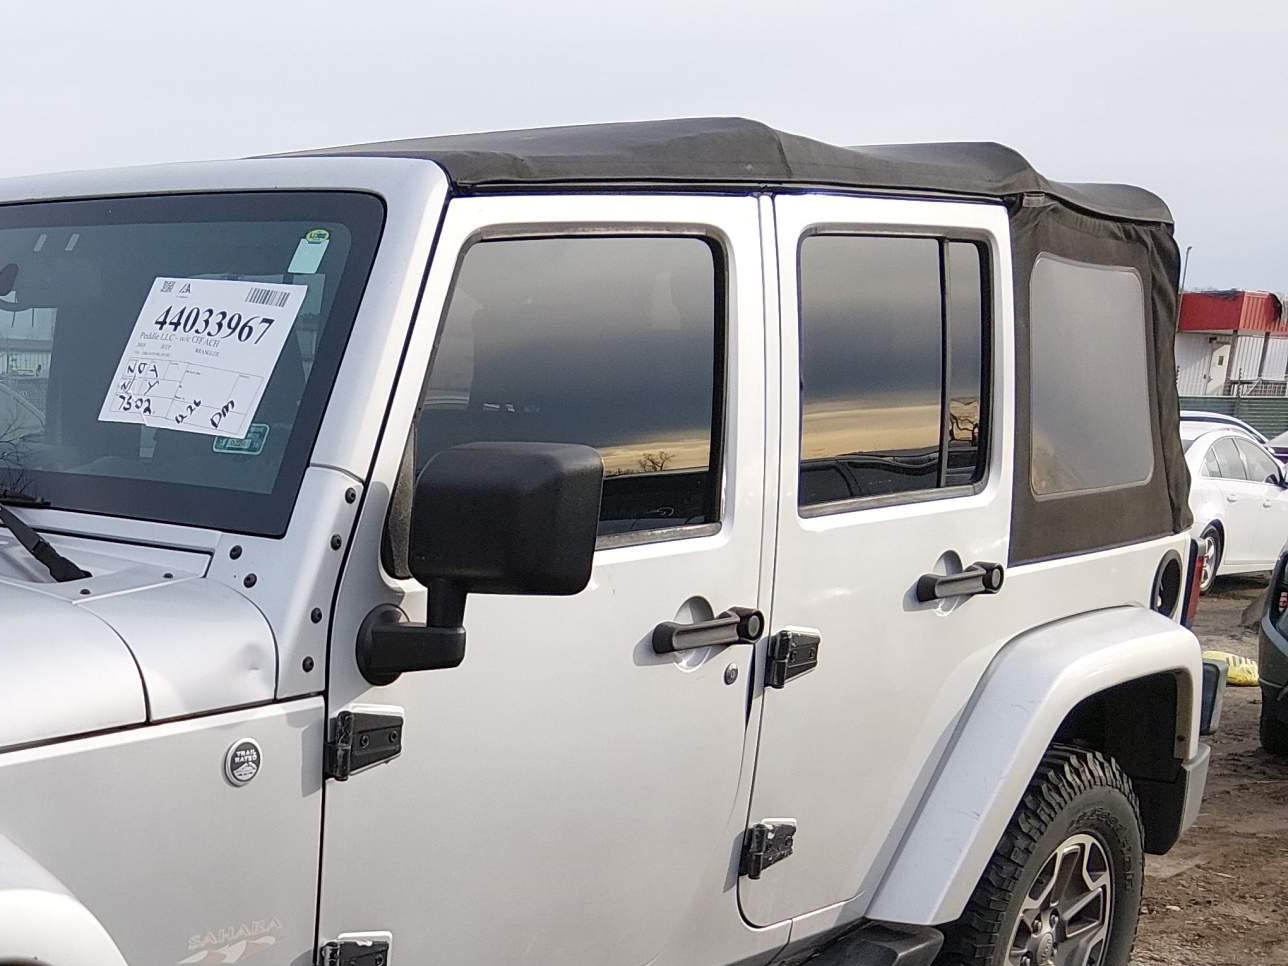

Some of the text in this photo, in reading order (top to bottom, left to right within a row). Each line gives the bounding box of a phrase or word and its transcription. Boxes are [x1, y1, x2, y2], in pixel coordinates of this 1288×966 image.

[155, 305, 275, 345] 44033967
[236, 749, 257, 757] TRAIL
[187, 917, 283, 950] SAHARA
